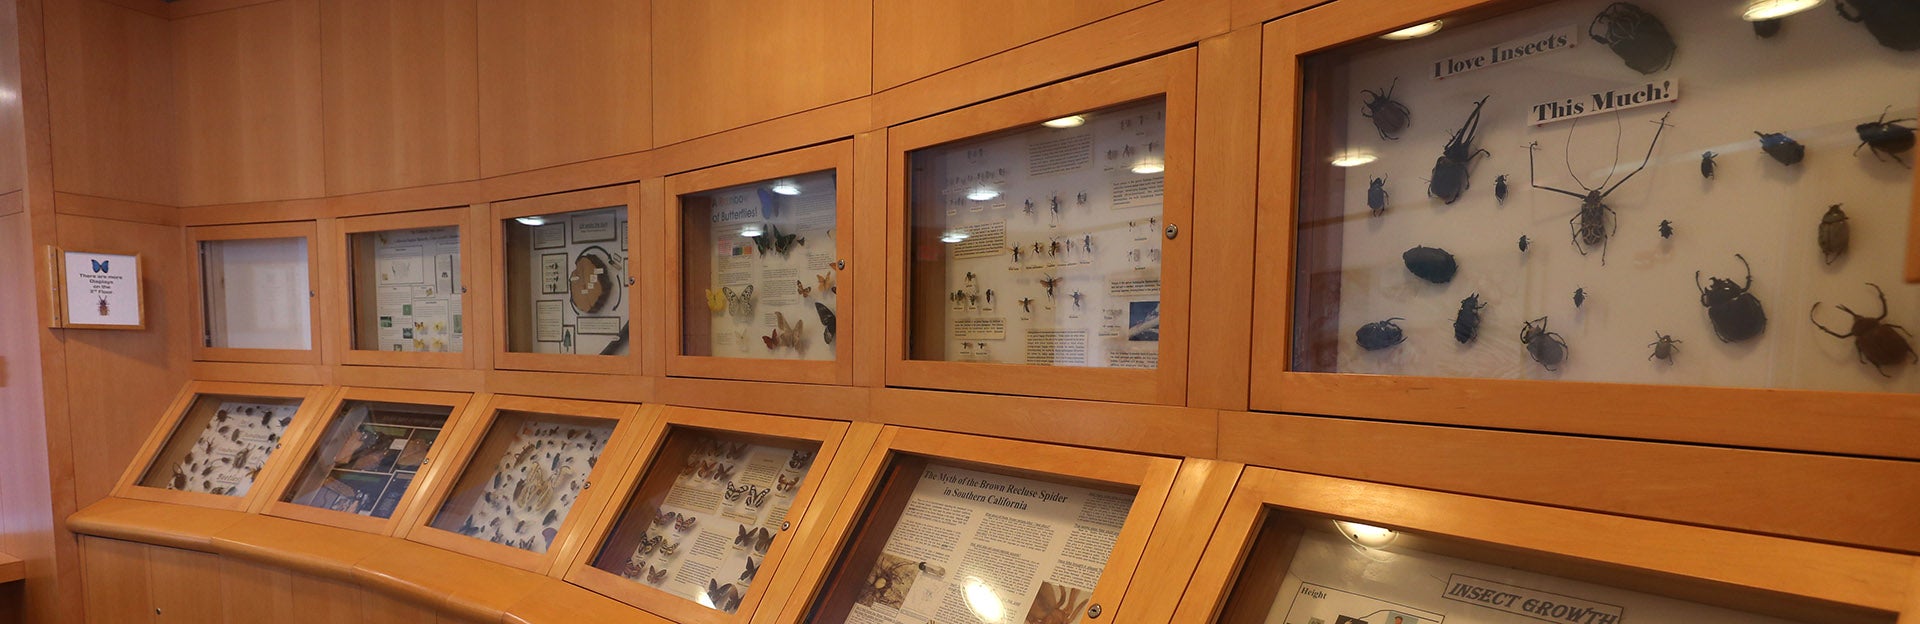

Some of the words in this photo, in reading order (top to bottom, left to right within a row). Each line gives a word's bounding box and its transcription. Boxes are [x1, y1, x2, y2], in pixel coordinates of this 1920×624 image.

[1433, 61, 1442, 78] I
[1448, 56, 1485, 74] love
[1491, 33, 1567, 64] Insects
[1533, 98, 1585, 122] This
[1591, 80, 1672, 112] Much!
[720, 207, 757, 221] Butterflies!
[923, 470, 936, 481] The
[938, 472, 958, 485] Myth
[957, 476, 967, 486] of
[967, 476, 979, 488] the
[979, 479, 1006, 493] Brown
[1006, 484, 1038, 498] Recluse
[1038, 490, 1069, 503] Spider
[943, 487, 951, 496] in
[952, 488, 986, 503] Southern
[987, 494, 1029, 511] California
[1300, 585, 1327, 601] Height
[1448, 583, 1522, 609] INSECT
[1522, 598, 1619, 624] GROWTH
